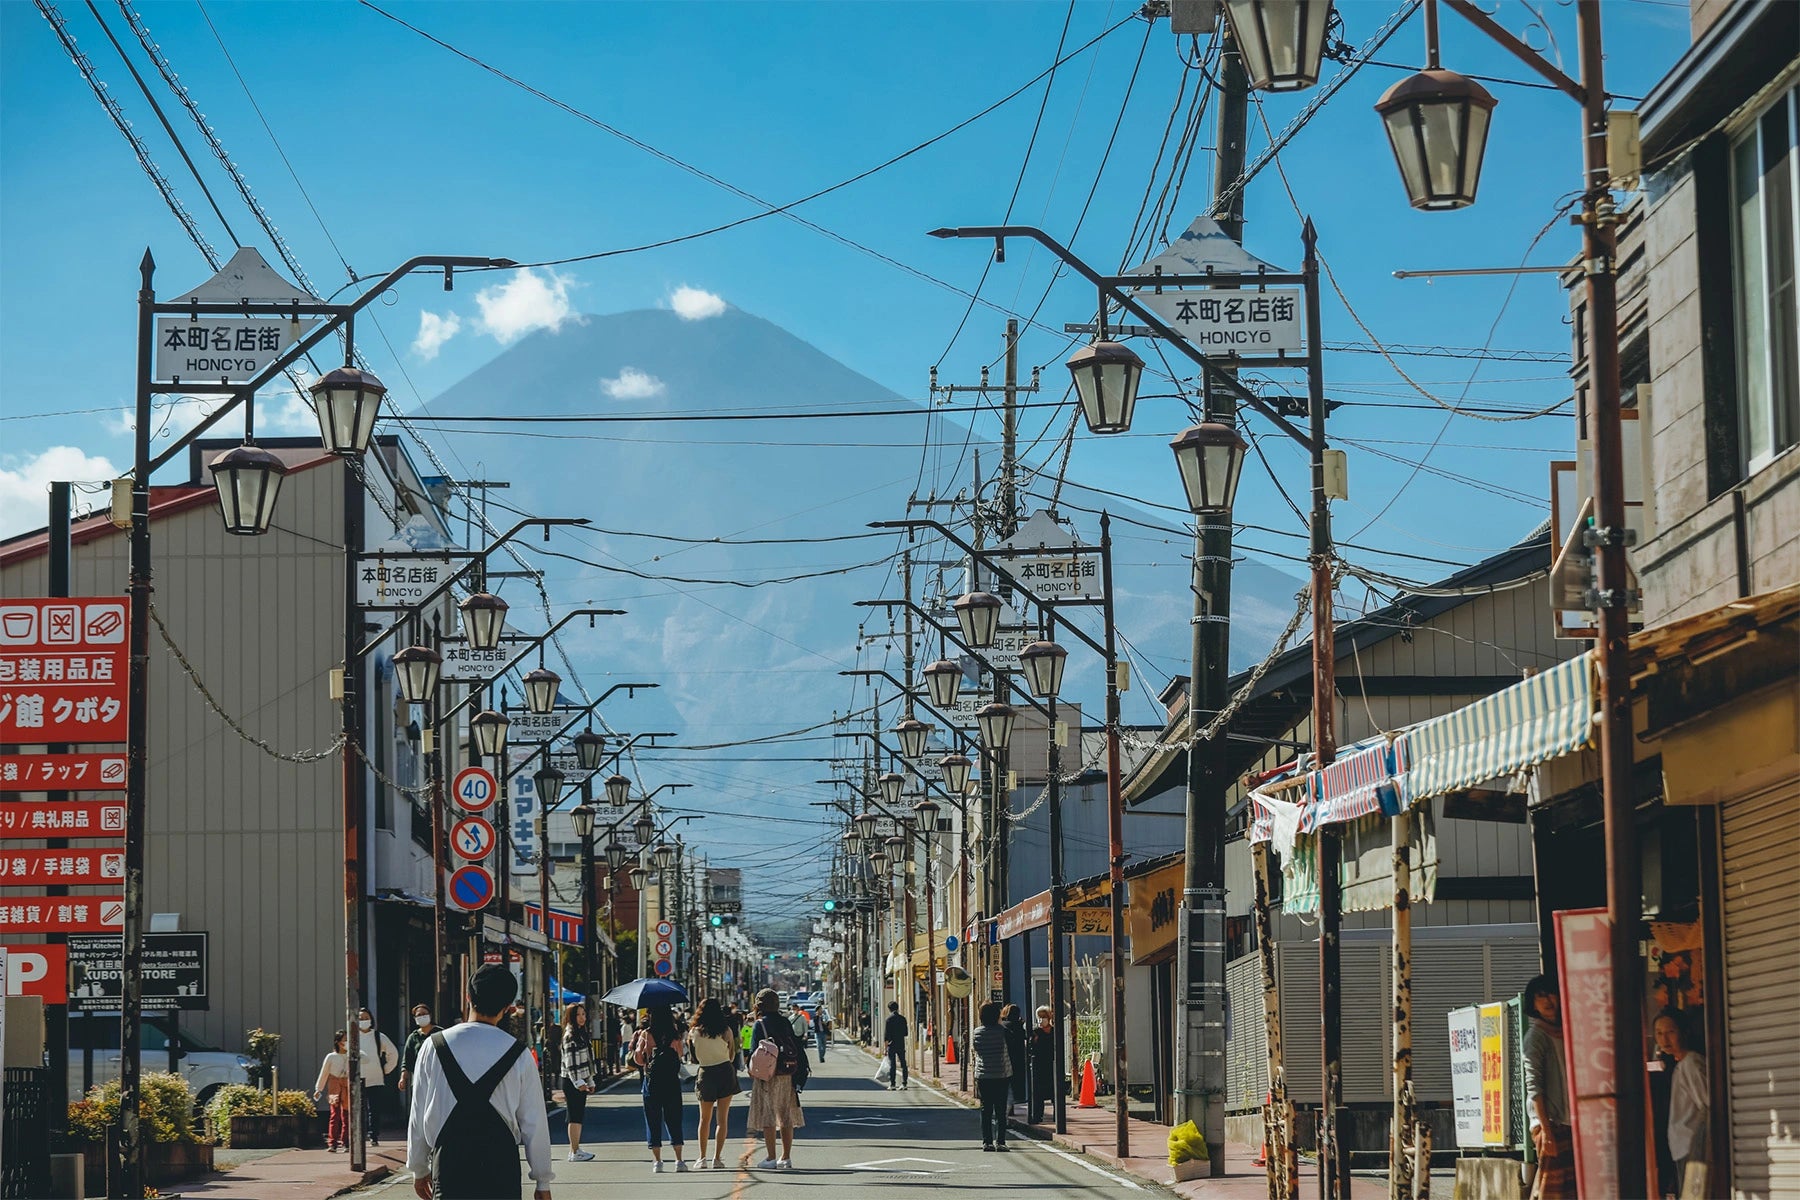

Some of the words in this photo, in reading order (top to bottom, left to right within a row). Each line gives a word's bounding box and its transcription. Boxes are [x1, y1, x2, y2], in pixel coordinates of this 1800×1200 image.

[1175, 296, 1295, 325] 本町名店街
[164, 326, 281, 352] 本町名店街
[361, 566, 438, 584] 本町名店街
[1020, 560, 1095, 580] 本町名店街
[446, 649, 507, 662] 本町名店街
[992, 654, 1018, 663] HONC
[0, 658, 113, 682] 包装用品店
[52, 696, 121, 724] クボタ
[511, 715, 562, 727] 本町名店街
[0, 762, 18, 781] 袋
[41, 761, 89, 781] ラップ
[462, 779, 487, 799] 40
[0, 811, 16, 829] り
[32, 810, 90, 829] 典礼用品
[44, 857, 91, 876] 手提袋
[58, 905, 89, 923] 割箸
[659, 925, 669, 934] 40
[92, 942, 121, 950] Kitchen
[7, 952, 49, 996] P
[83, 970, 123, 981] KUBOT
